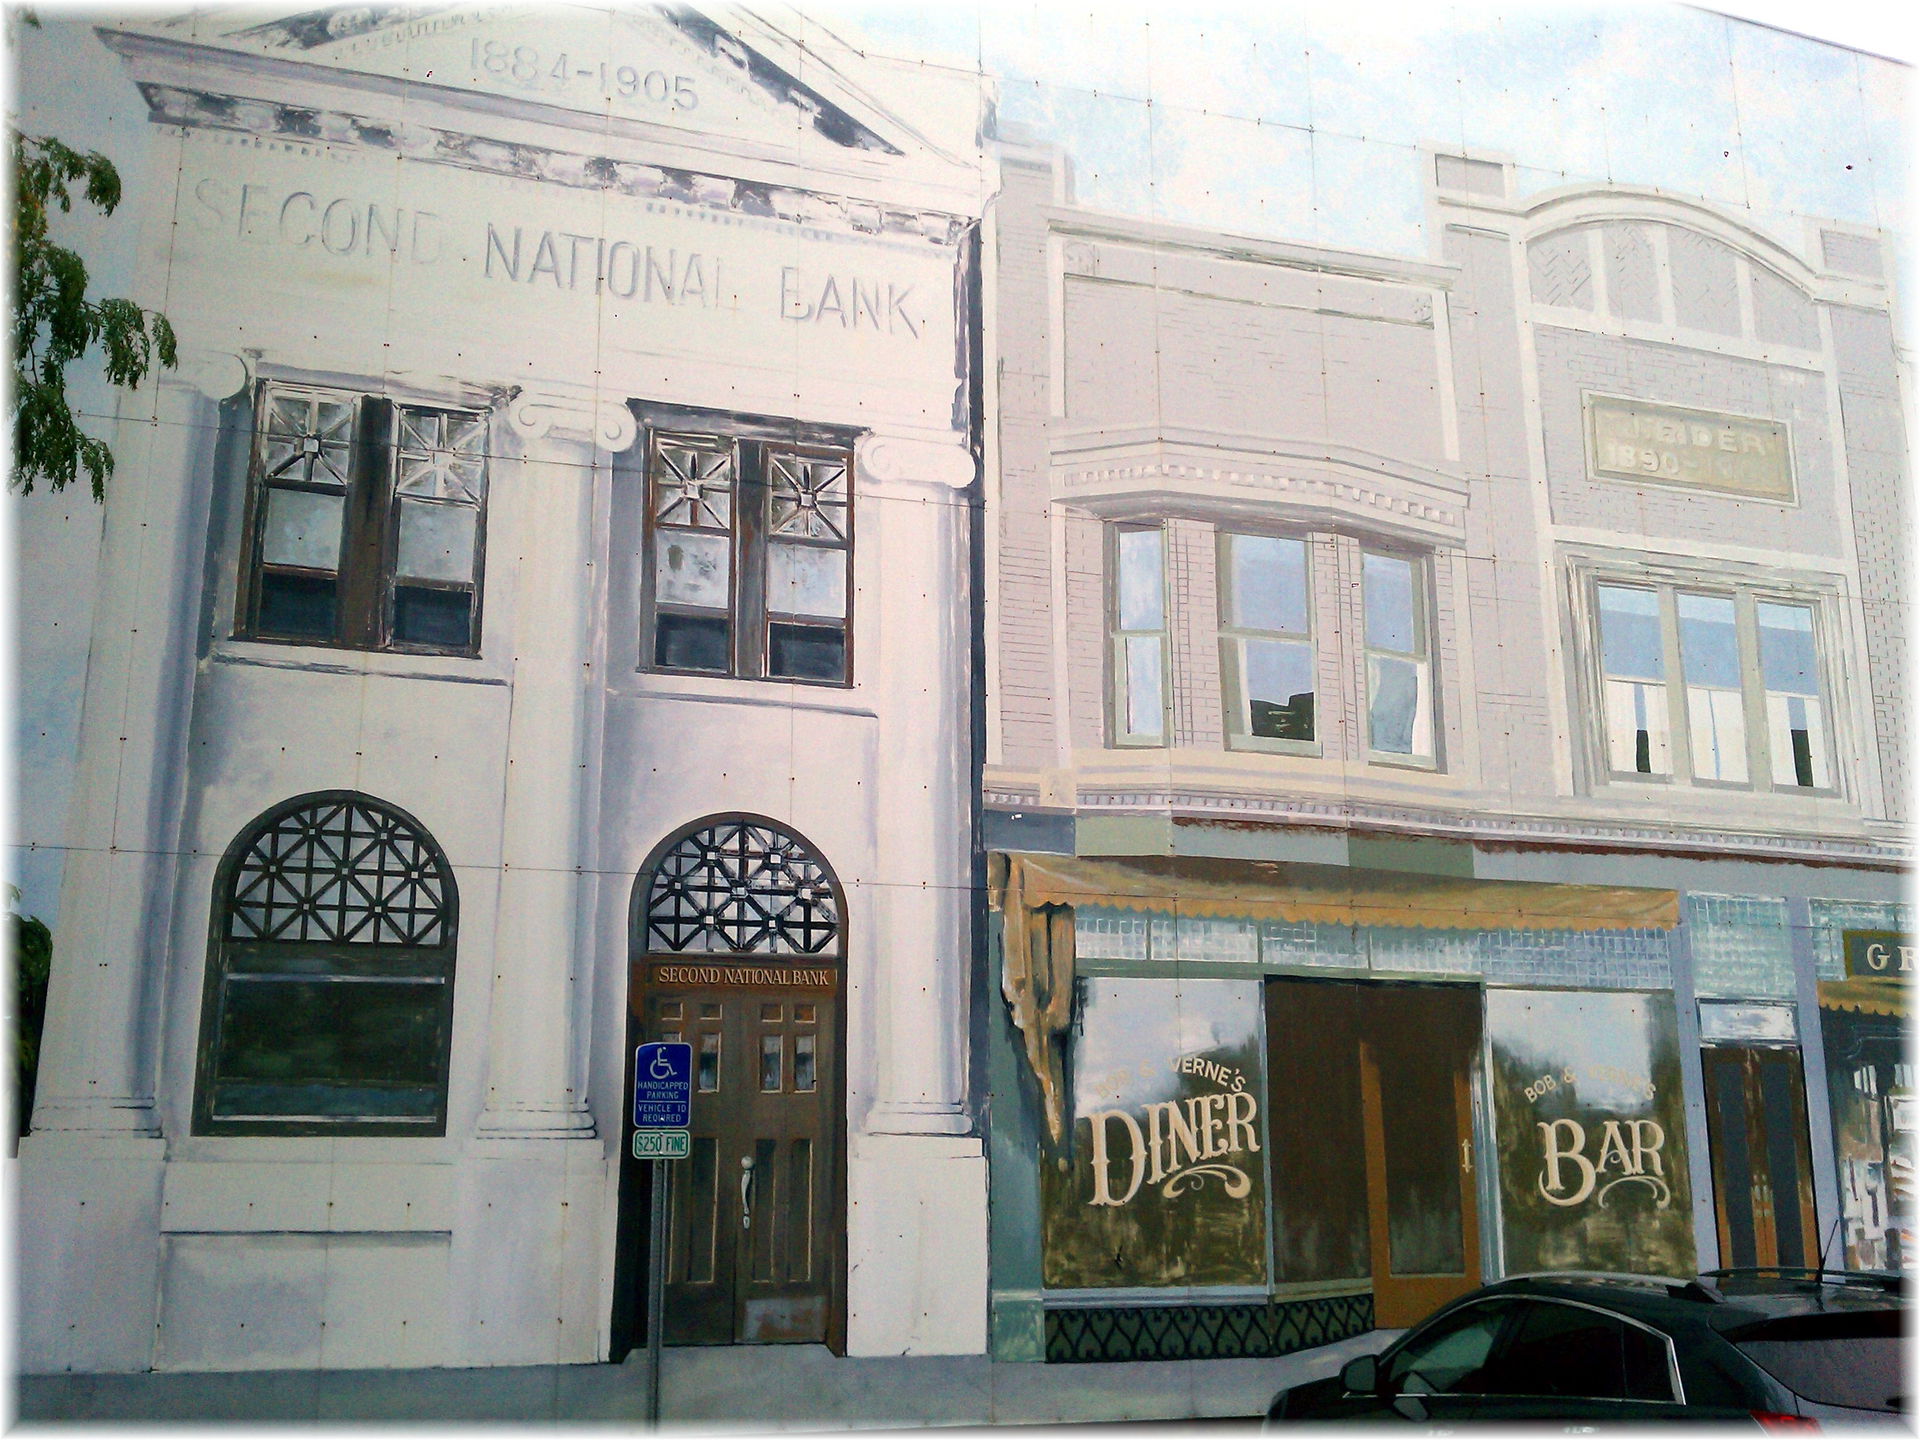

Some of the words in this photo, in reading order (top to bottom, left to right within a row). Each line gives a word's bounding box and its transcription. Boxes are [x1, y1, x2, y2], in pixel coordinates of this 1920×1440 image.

[471, 37, 699, 111] 1884-1905
[194, 177, 442, 265] SECOND
[484, 222, 740, 311] NATIONAL
[780, 265, 919, 339] BANK
[659, 967, 720, 984] SECOND
[724, 968, 790, 986] NATIONAL
[792, 969, 829, 986] BANK
[637, 1081, 689, 1090] HANDICAPPED
[1167, 1056, 1247, 1092] VERNE'S
[1523, 1074, 1556, 1103] BOB
[1563, 1065, 1577, 1084] &
[638, 1103, 671, 1112] VEHICLE
[677, 1104, 687, 1112] ID
[646, 1091, 679, 1099] PARKING
[637, 1136, 662, 1152] $250
[666, 1136, 686, 1152] FINE
[1086, 1091, 1261, 1206] DINER
[1536, 1118, 1665, 1207] BAR
